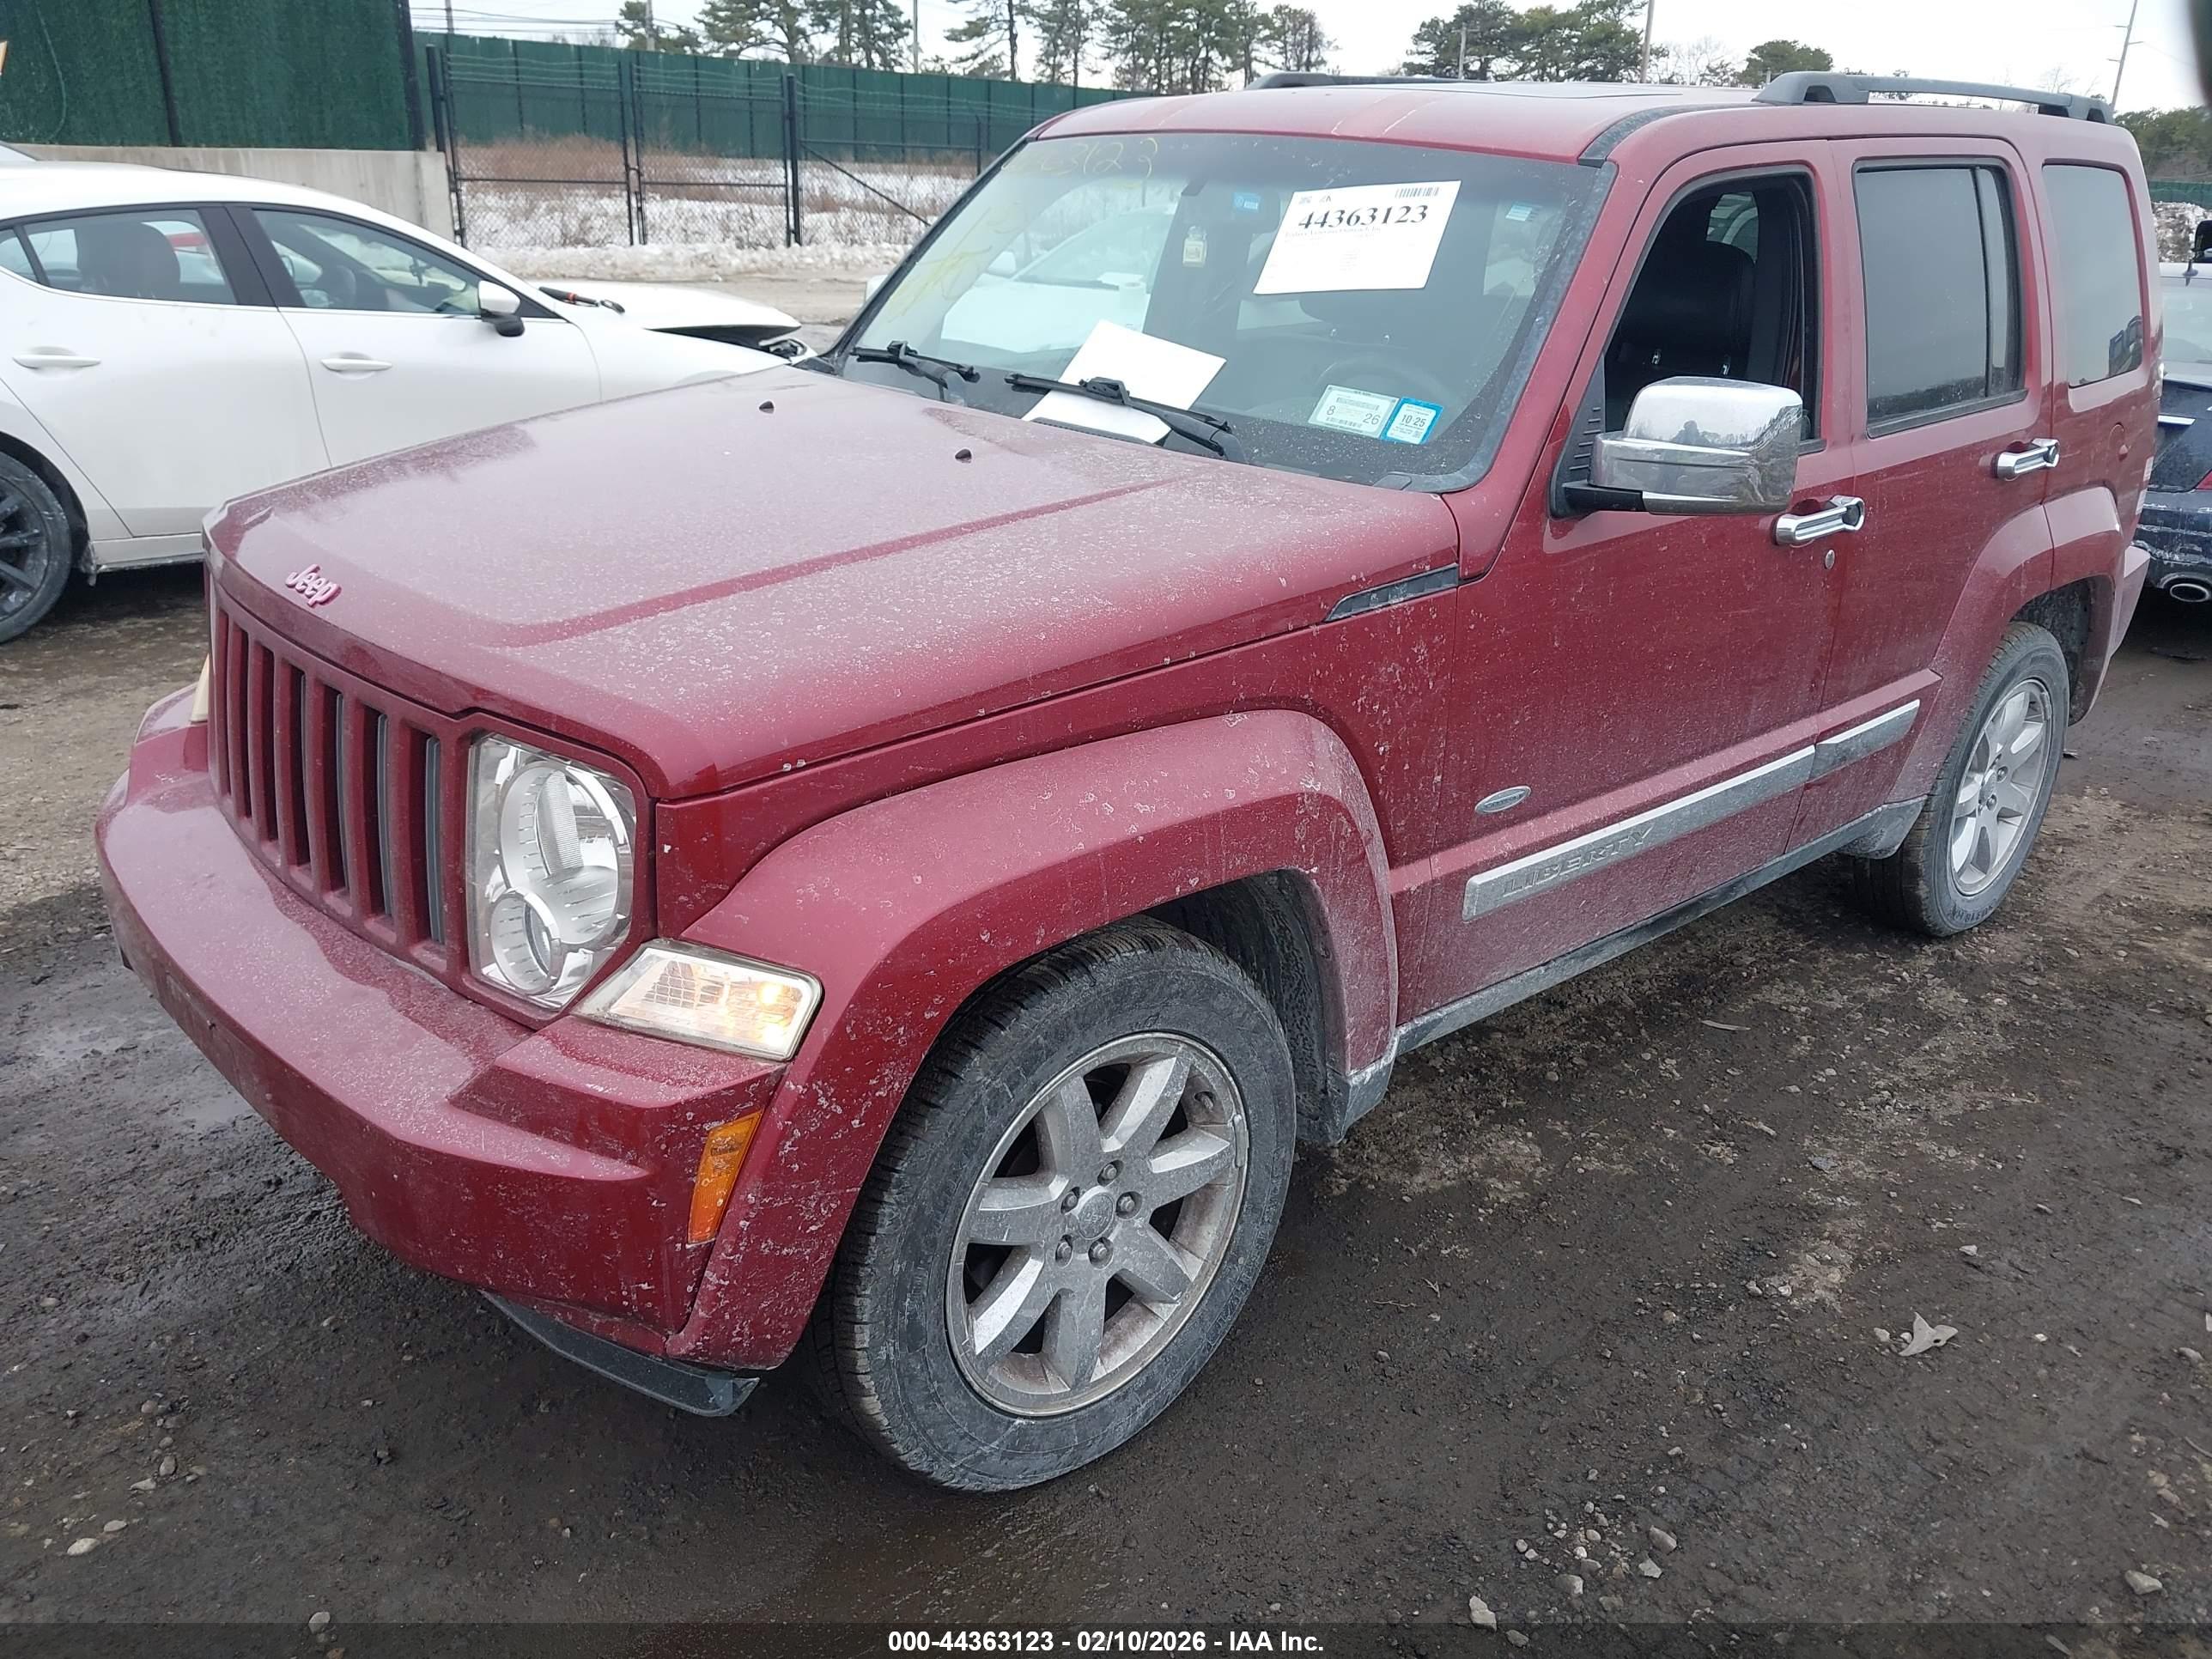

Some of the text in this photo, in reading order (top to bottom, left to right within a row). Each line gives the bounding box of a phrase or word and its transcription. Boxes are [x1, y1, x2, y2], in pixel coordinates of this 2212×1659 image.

[1297, 204, 1429, 229] 44363123
[1326, 404, 1336, 416] 8
[1362, 413, 1382, 425] 26
[285, 563, 343, 608] Jeep
[1502, 824, 1655, 896] LIBERTY
